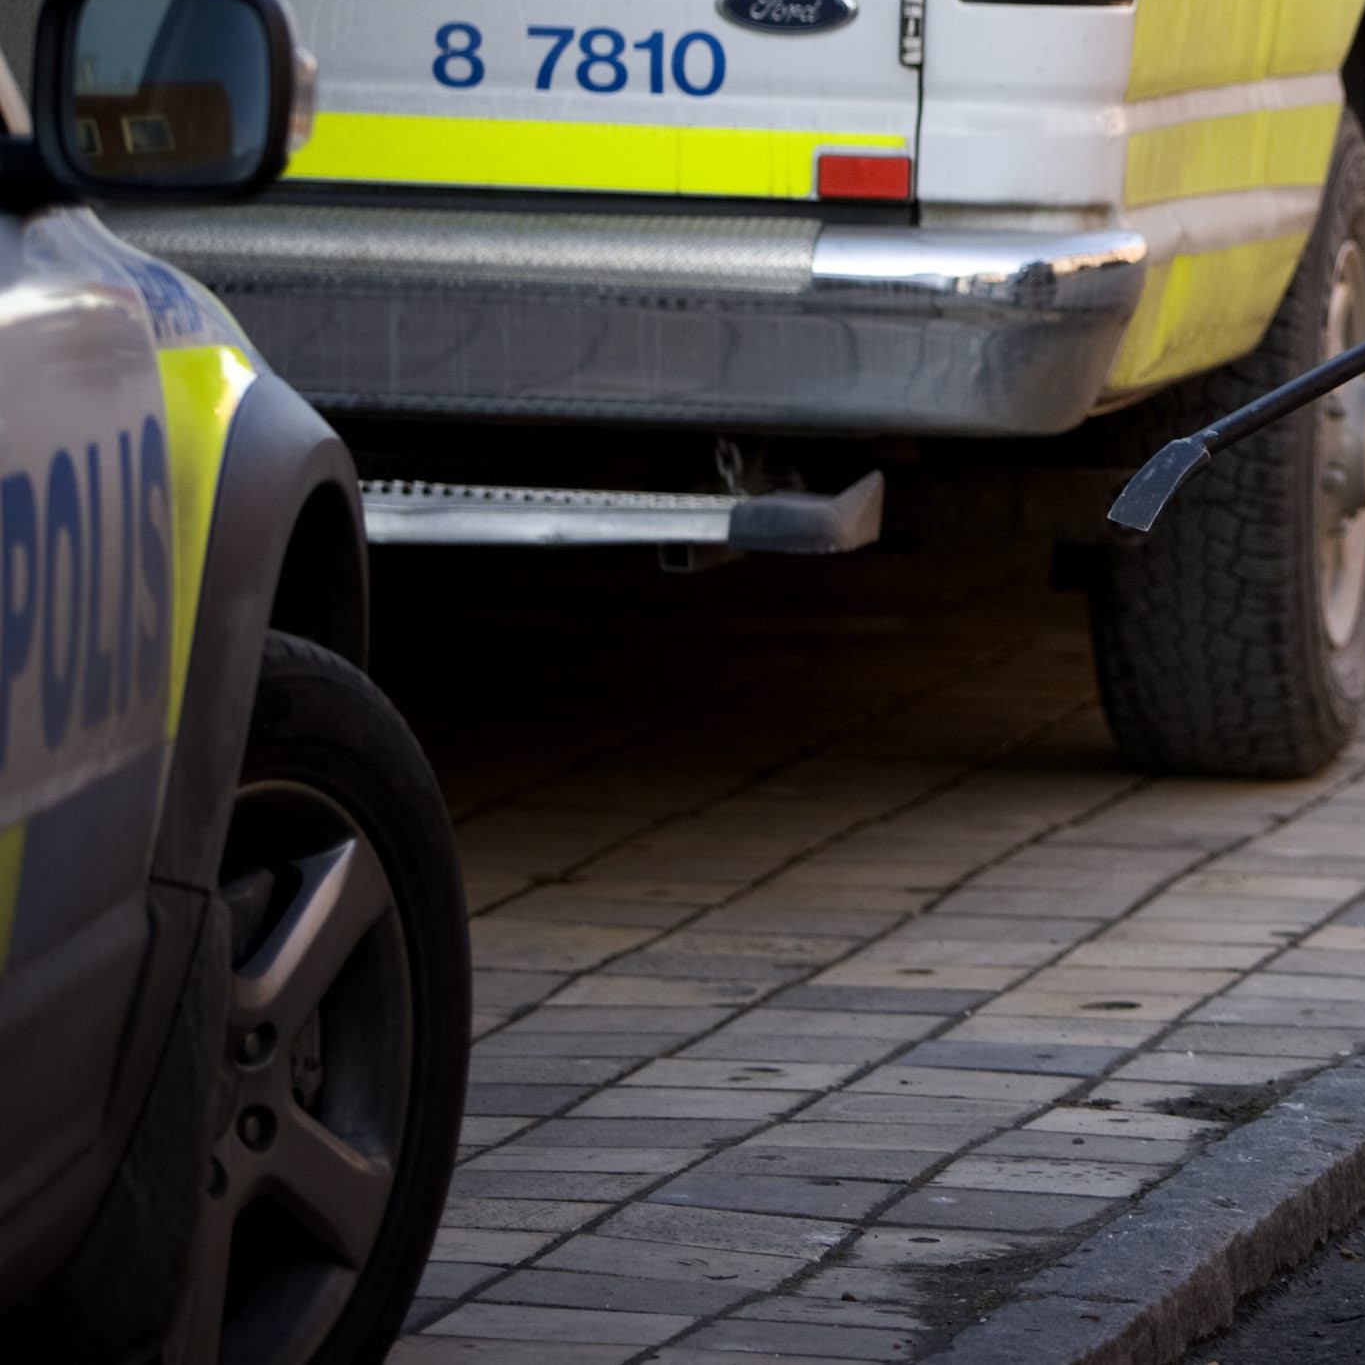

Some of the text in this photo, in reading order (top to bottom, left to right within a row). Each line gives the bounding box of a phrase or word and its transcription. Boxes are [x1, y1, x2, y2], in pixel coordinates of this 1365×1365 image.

[432, 21, 726, 98] 8 7810
[0, 413, 172, 771] POLIS
